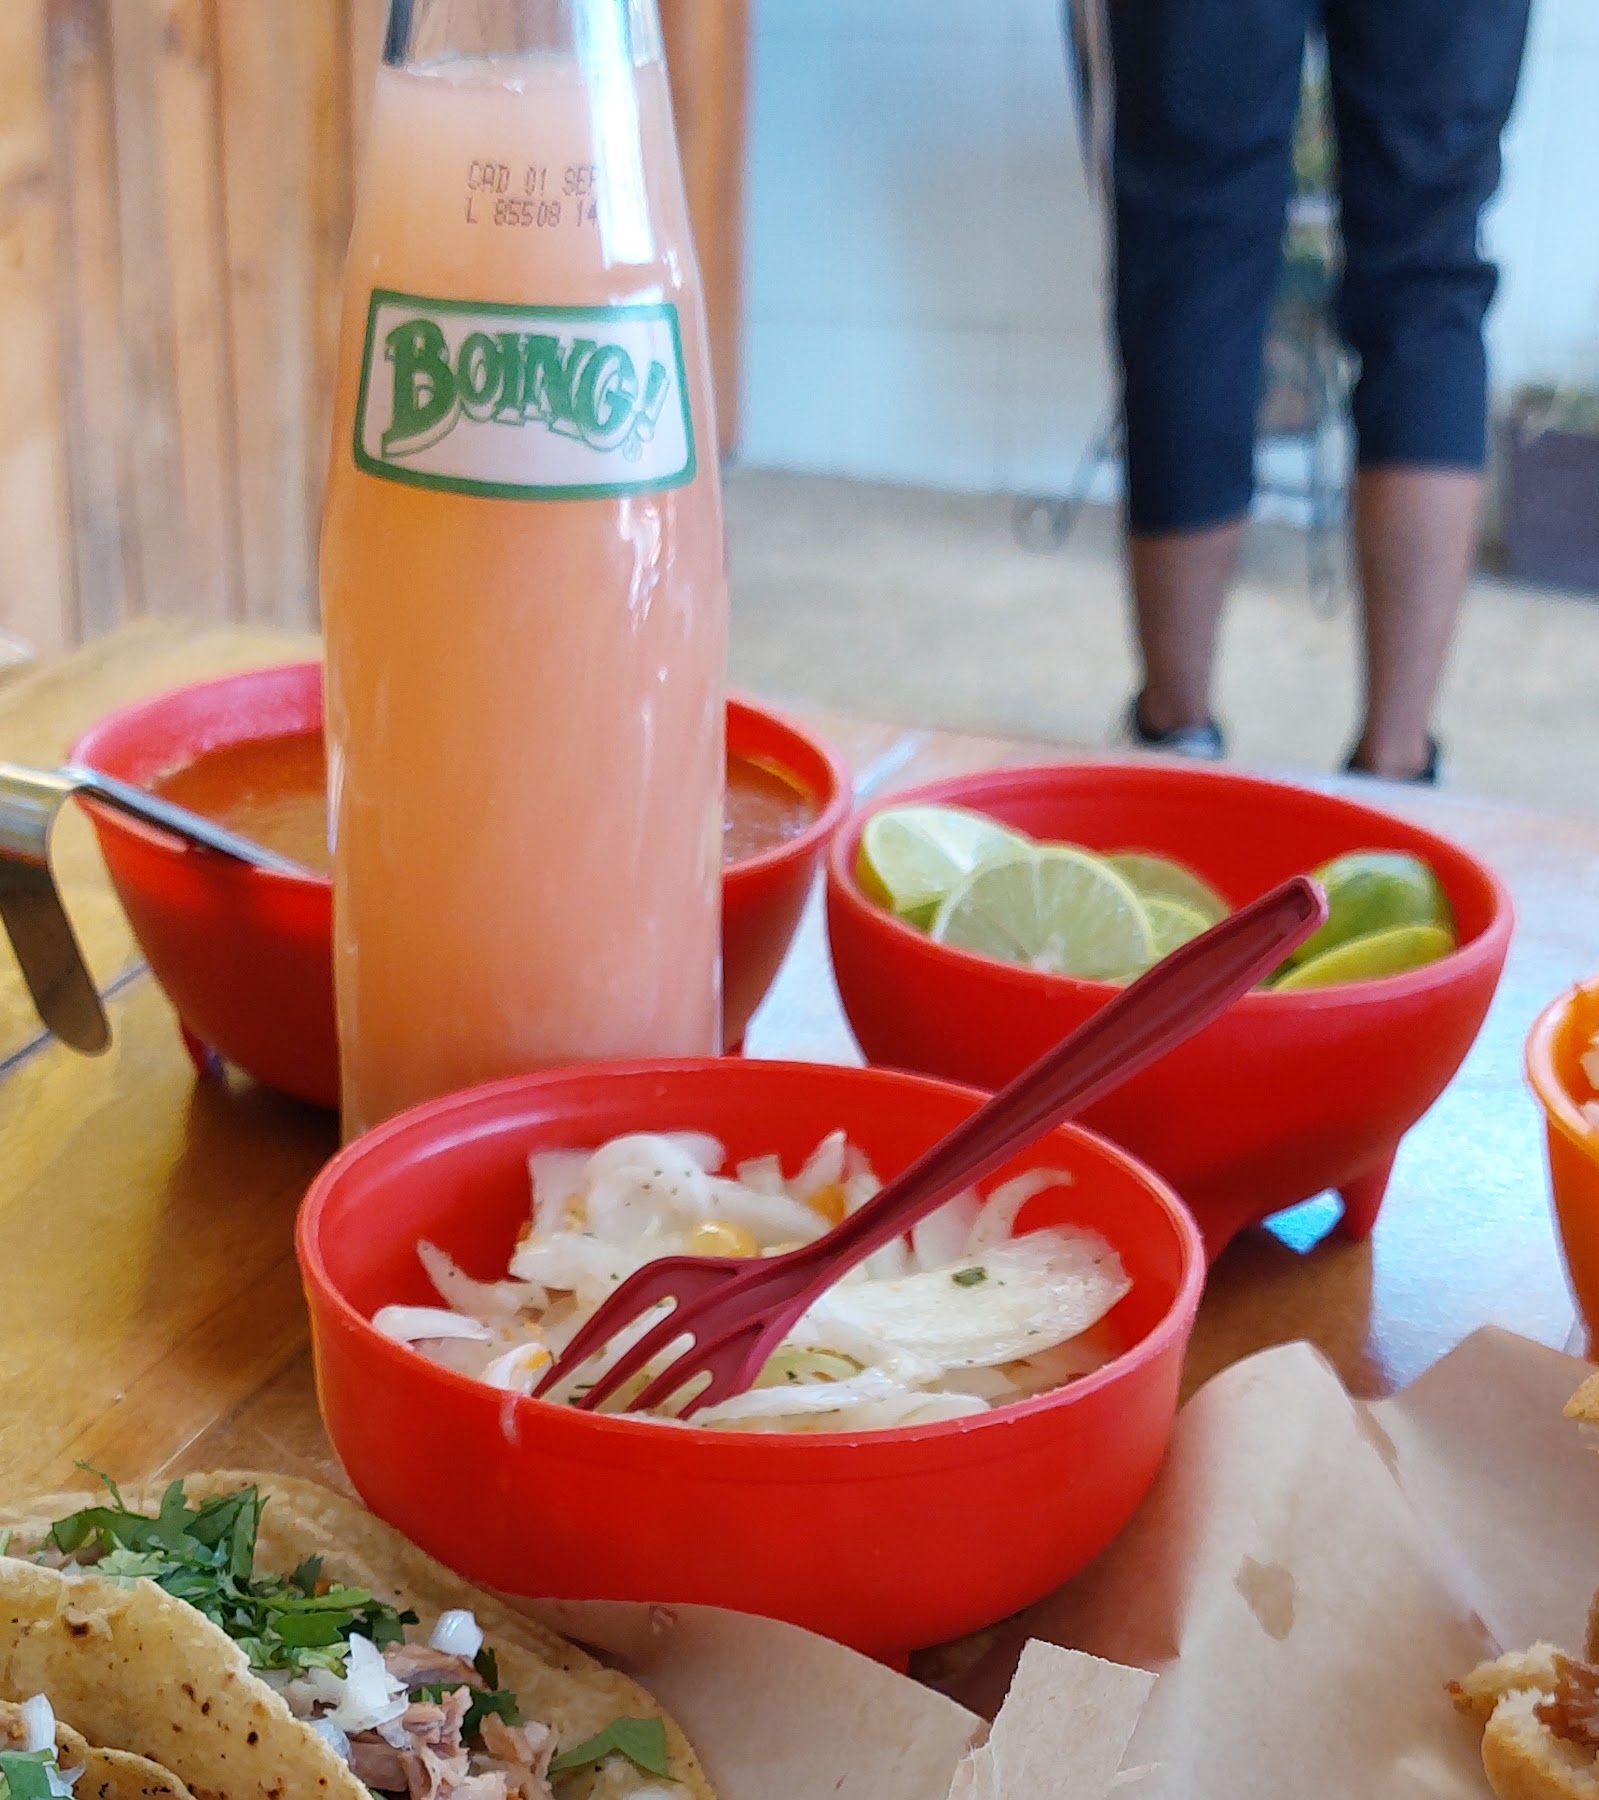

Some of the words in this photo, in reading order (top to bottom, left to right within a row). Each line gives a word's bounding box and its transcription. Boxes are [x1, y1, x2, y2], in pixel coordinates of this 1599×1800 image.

[468, 160, 510, 194] CAD
[525, 167, 546, 196] 01
[465, 197, 478, 225] L
[382, 318, 671, 461] BOING!
